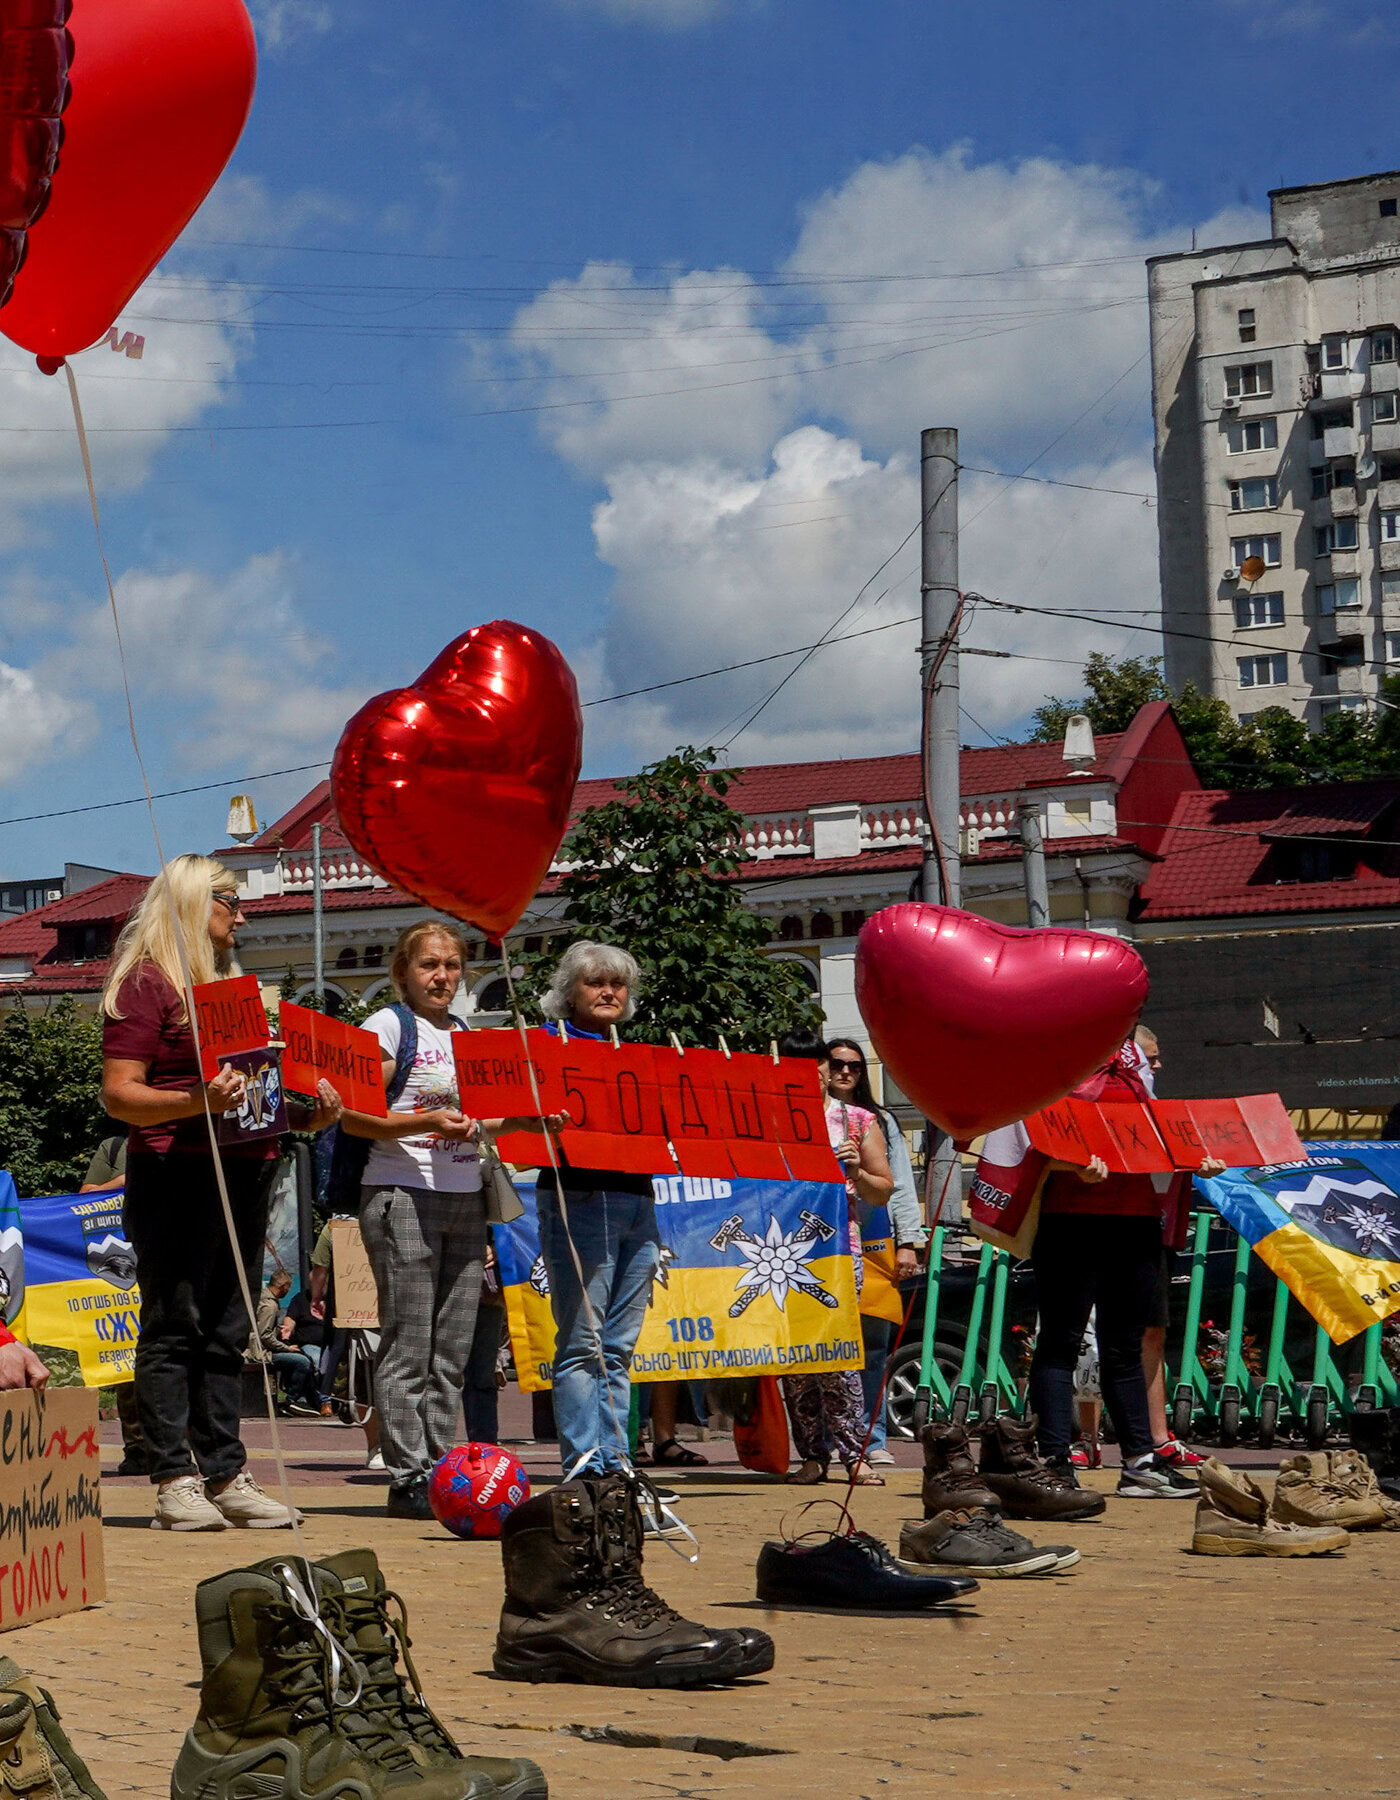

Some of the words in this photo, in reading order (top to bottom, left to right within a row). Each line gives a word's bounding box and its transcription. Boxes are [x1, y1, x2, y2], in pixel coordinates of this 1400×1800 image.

[66, 1299, 81, 1313] 10
[82, 1294, 111, 1310] ОГШБ
[112, 1292, 130, 1308] 109
[667, 1315, 715, 1342] 108
[777, 1337, 861, 1366] БАТАЛЬЙОН
[476, 1455, 511, 1505] ENGLAND
